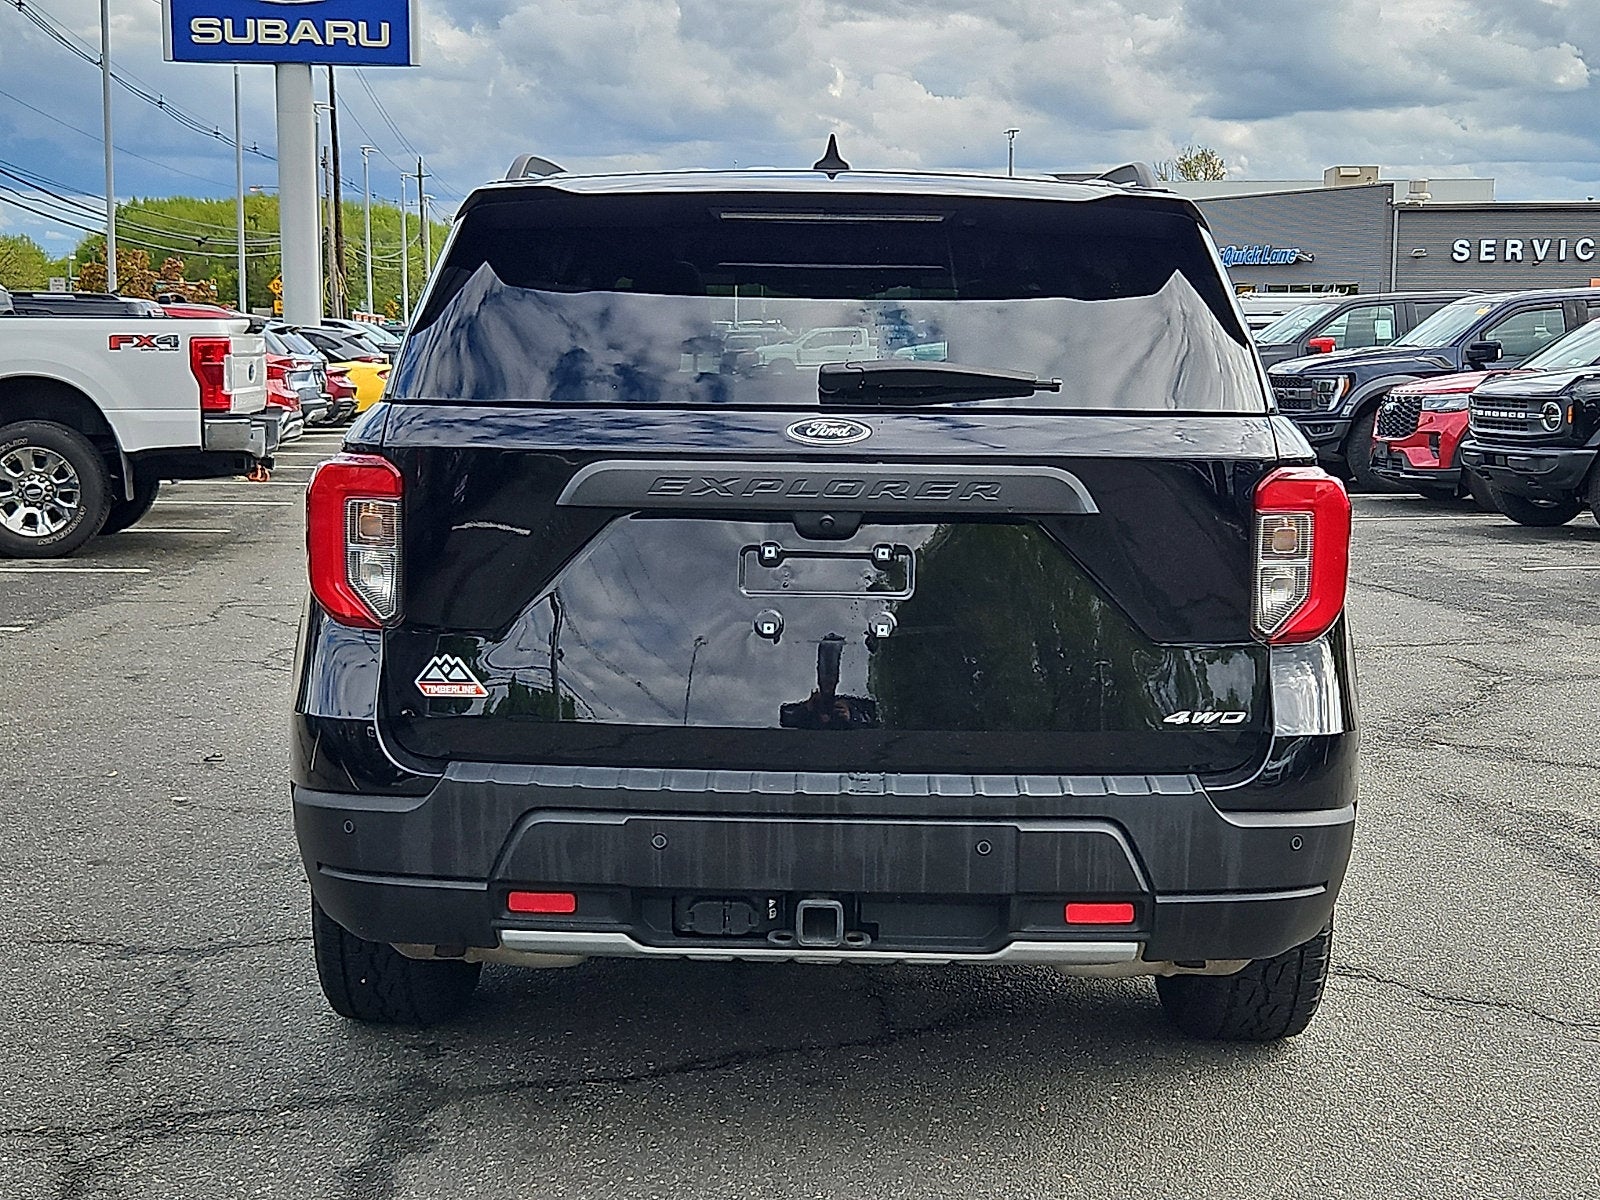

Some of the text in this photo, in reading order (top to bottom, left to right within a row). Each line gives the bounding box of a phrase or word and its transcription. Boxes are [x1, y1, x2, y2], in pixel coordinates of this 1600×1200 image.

[190, 17, 391, 48] SUBARU
[1222, 244, 1300, 267] Quick Lane
[1451, 237, 1596, 262] SERVIC
[109, 334, 179, 351] FX4
[805, 421, 853, 437] Ford
[647, 475, 1002, 501] EXPLORER
[424, 684, 477, 694] TIMBERLINE
[1162, 710, 1247, 725] 4WD
